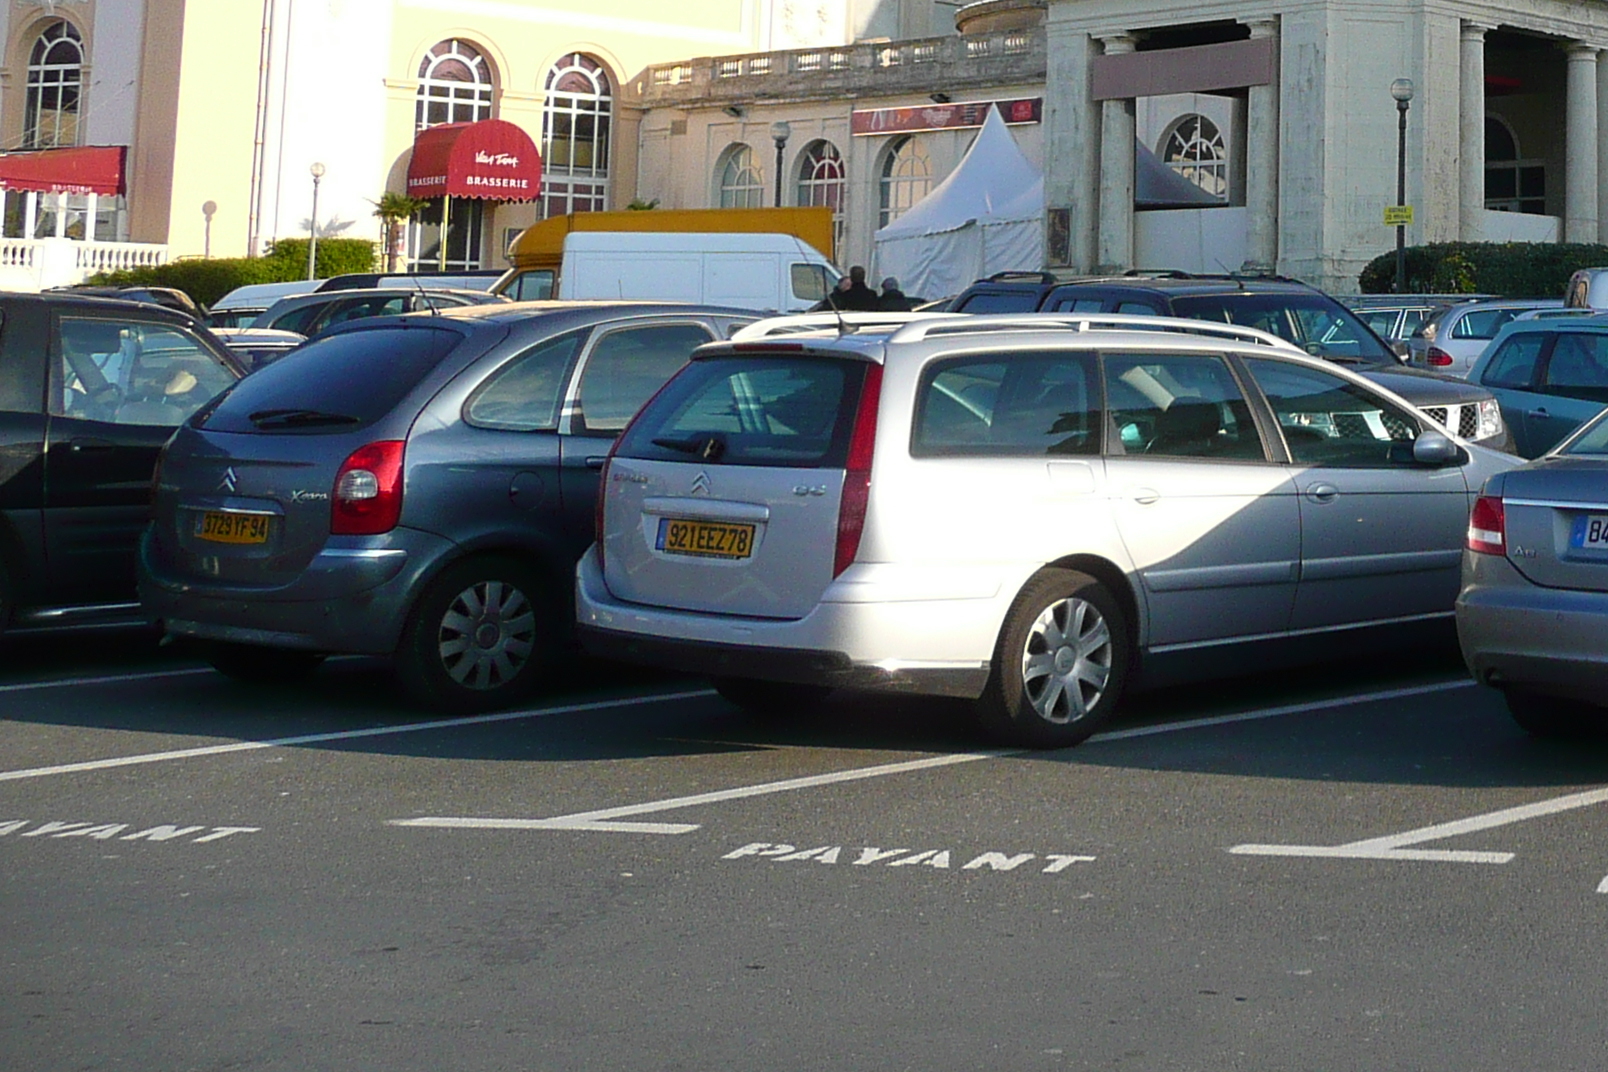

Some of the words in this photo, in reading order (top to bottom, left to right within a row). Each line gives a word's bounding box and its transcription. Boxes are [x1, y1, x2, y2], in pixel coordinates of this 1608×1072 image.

[409, 176, 446, 187] BRASSERIE
[467, 176, 528, 189] BRASSERIE
[204, 514, 233, 536] 3729
[234, 516, 250, 536] YF
[249, 516, 267, 539] 94
[720, 842, 1097, 874] PAYANT
